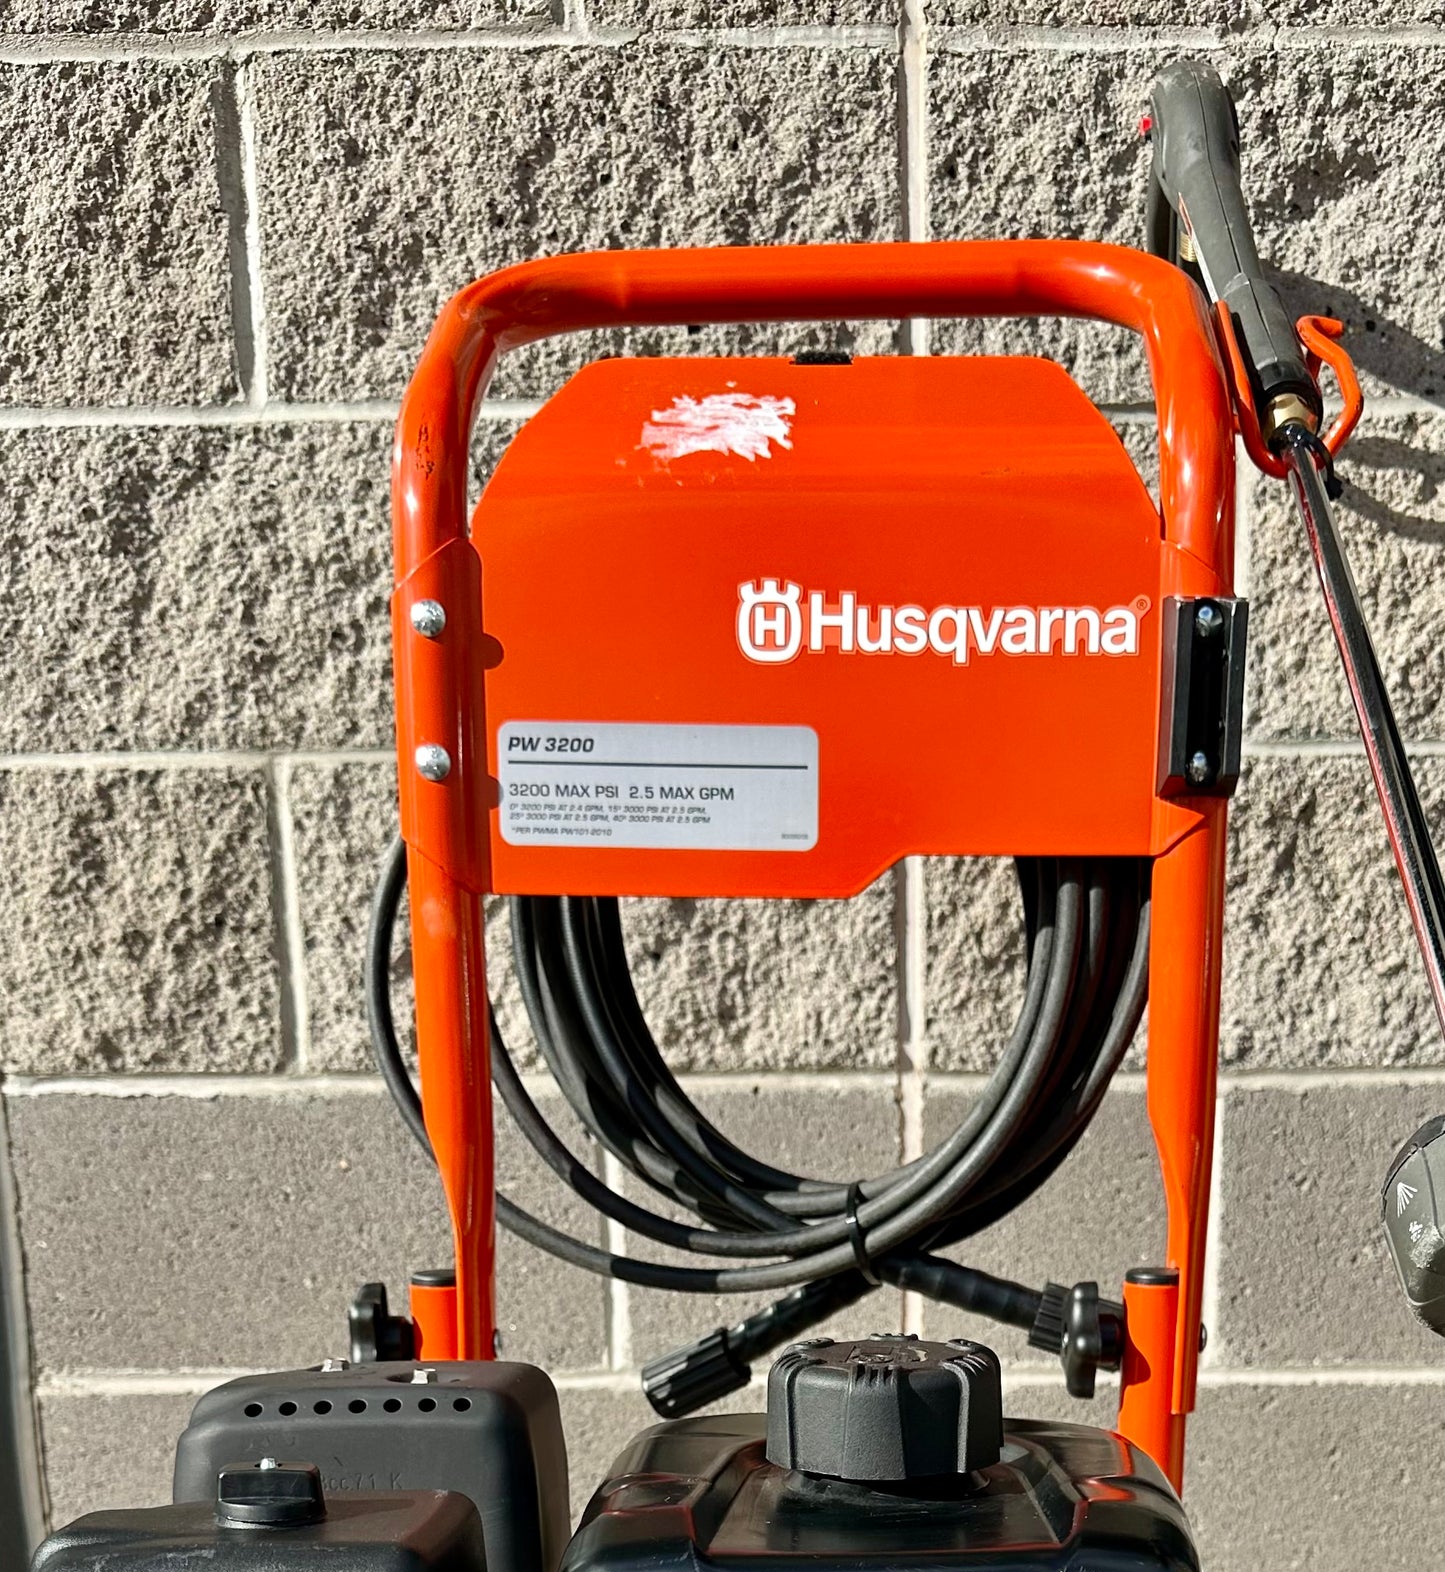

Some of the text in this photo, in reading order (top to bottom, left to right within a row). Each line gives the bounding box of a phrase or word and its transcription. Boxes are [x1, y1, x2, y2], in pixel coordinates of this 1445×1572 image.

[508, 736, 595, 753] PW 3200
[509, 783, 735, 801] 3200 MAX PSI 2.5 MAX GPM
[520, 803, 542, 811] 3200
[558, 804, 567, 812] AT
[646, 806, 659, 814] PSI
[660, 806, 670, 814] AT
[549, 813, 562, 821] PSI
[666, 816, 675, 824] AT
[692, 816, 711, 824] GPM
